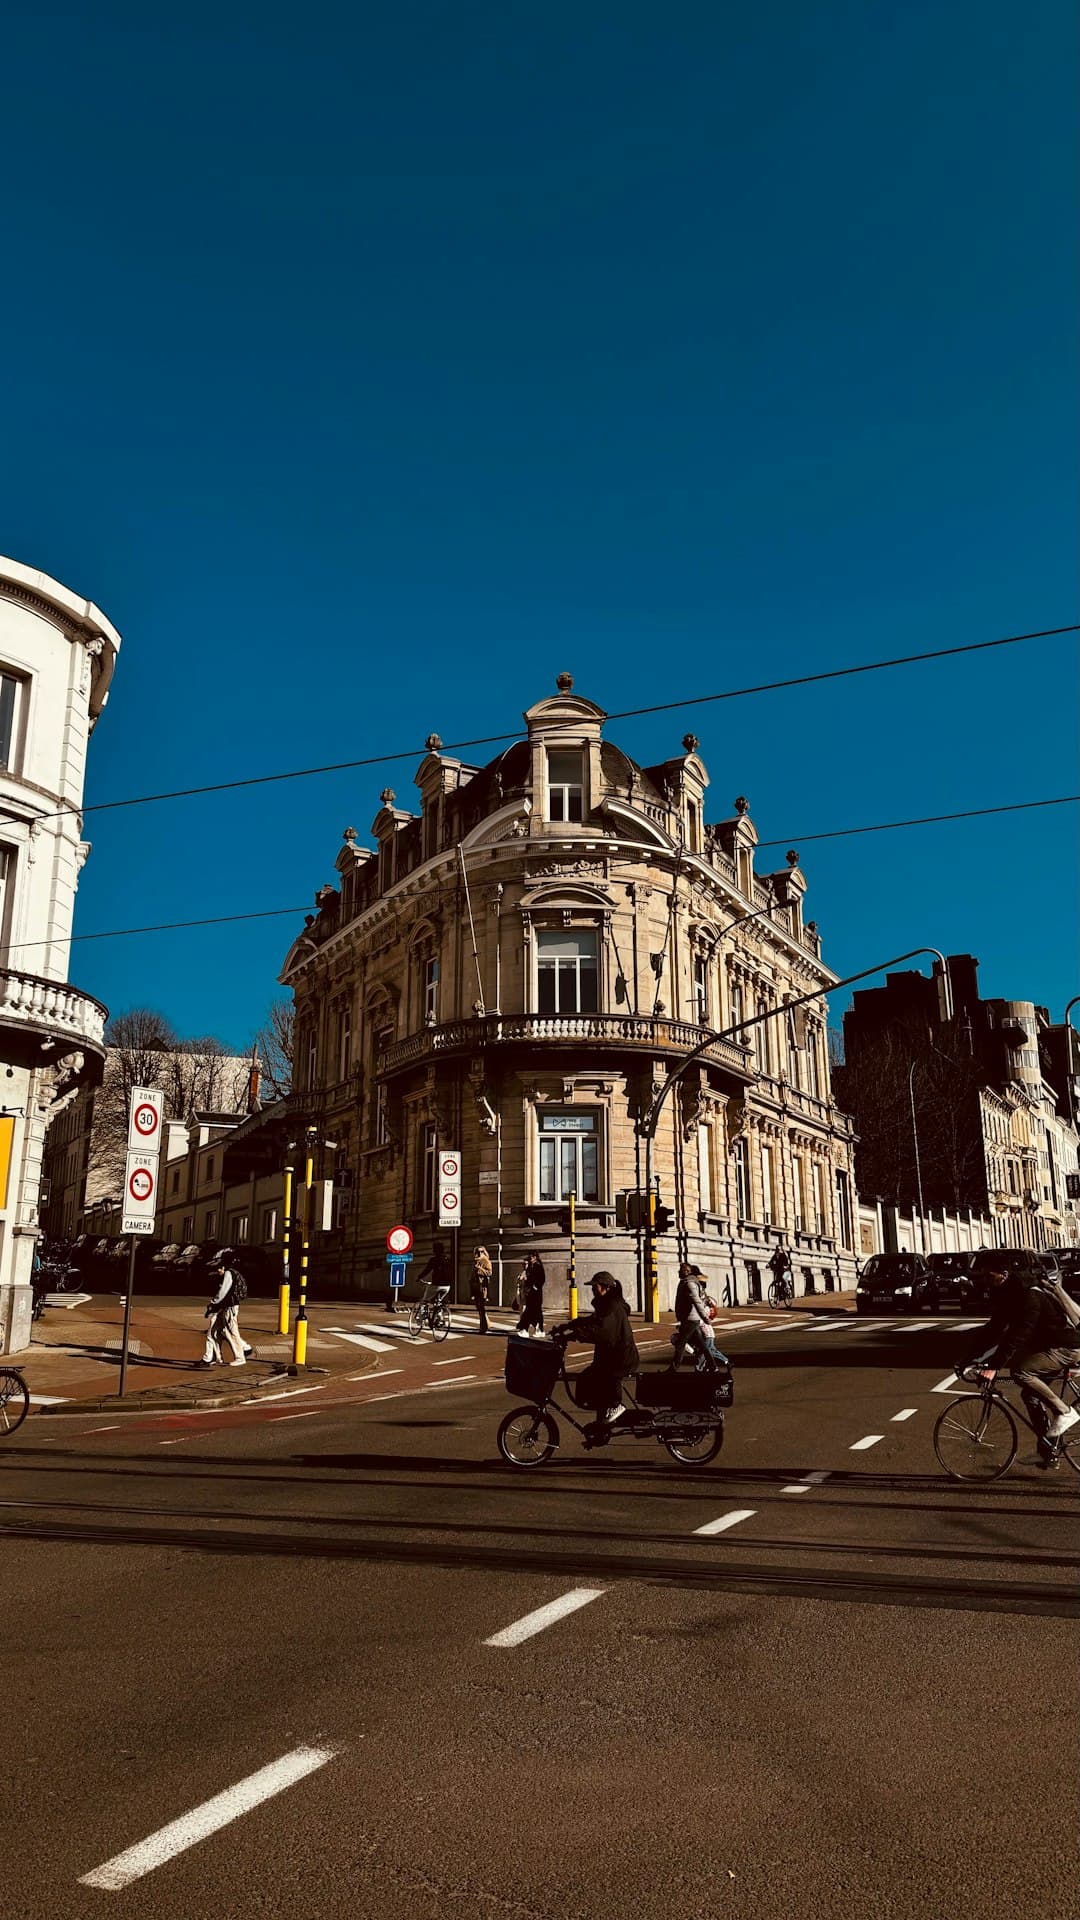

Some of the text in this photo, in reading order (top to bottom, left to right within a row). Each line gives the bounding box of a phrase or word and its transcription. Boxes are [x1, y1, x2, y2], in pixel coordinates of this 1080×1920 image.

[139, 1092, 156, 1102] ZONE
[139, 1112, 153, 1126] 30
[134, 1157, 152, 1166] ZONE
[124, 1219, 152, 1231] CAMERA
